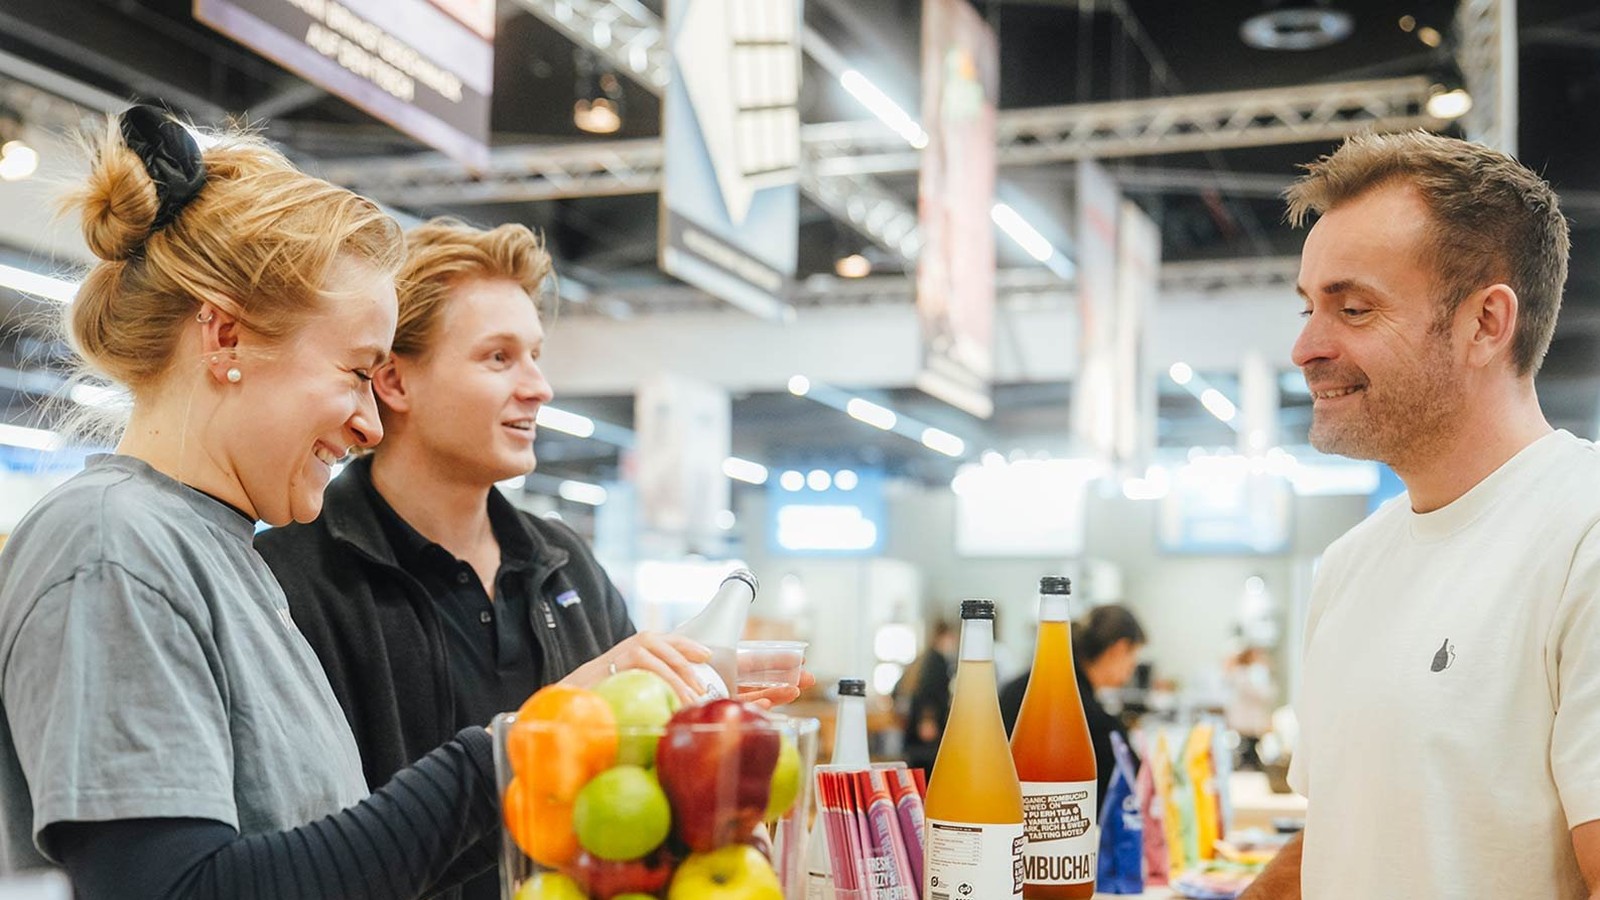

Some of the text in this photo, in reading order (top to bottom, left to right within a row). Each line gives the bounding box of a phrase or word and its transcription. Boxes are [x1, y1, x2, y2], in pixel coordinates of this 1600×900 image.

[1023, 792, 1087, 804] GANIC KOMBUCHA
[1023, 802, 1061, 811] EWED ON
[1056, 808, 1071, 817] TEA
[1028, 817, 1059, 826] VANILLA
[1060, 814, 1080, 823] BEAN
[1023, 825, 1041, 833] ARK,
[1041, 823, 1060, 832] RICH
[1028, 828, 1084, 840] TASTING NOTES
[1023, 854, 1090, 880] MBUCHA
